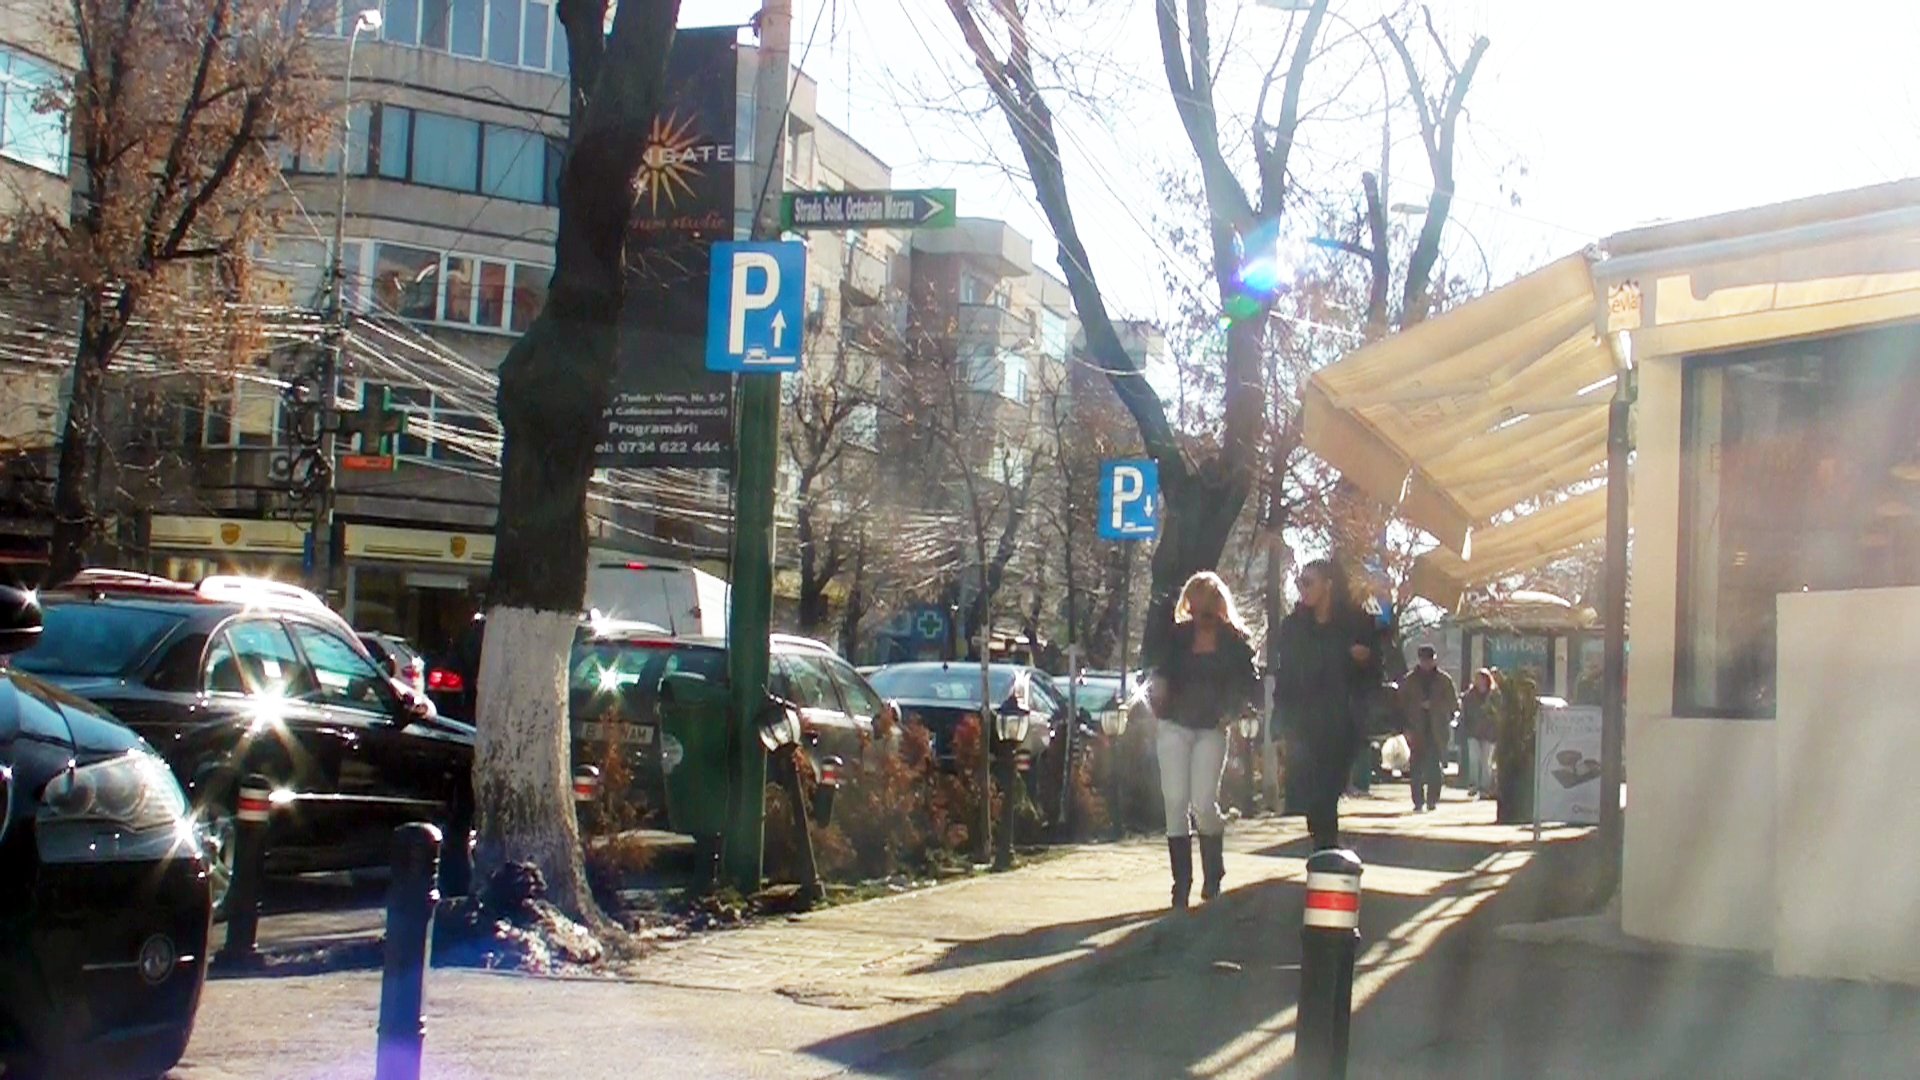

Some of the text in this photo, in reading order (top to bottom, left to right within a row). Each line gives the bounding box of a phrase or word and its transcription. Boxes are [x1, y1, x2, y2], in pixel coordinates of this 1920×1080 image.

[794, 197, 822, 222] Strada
[845, 195, 883, 220] Octavian
[884, 195, 914, 220] Moraru
[729, 252, 780, 354] P
[617, 441, 656, 453] 0734
[659, 441, 688, 453] 622
[691, 441, 720, 453] 444
[1112, 466, 1144, 529] P
